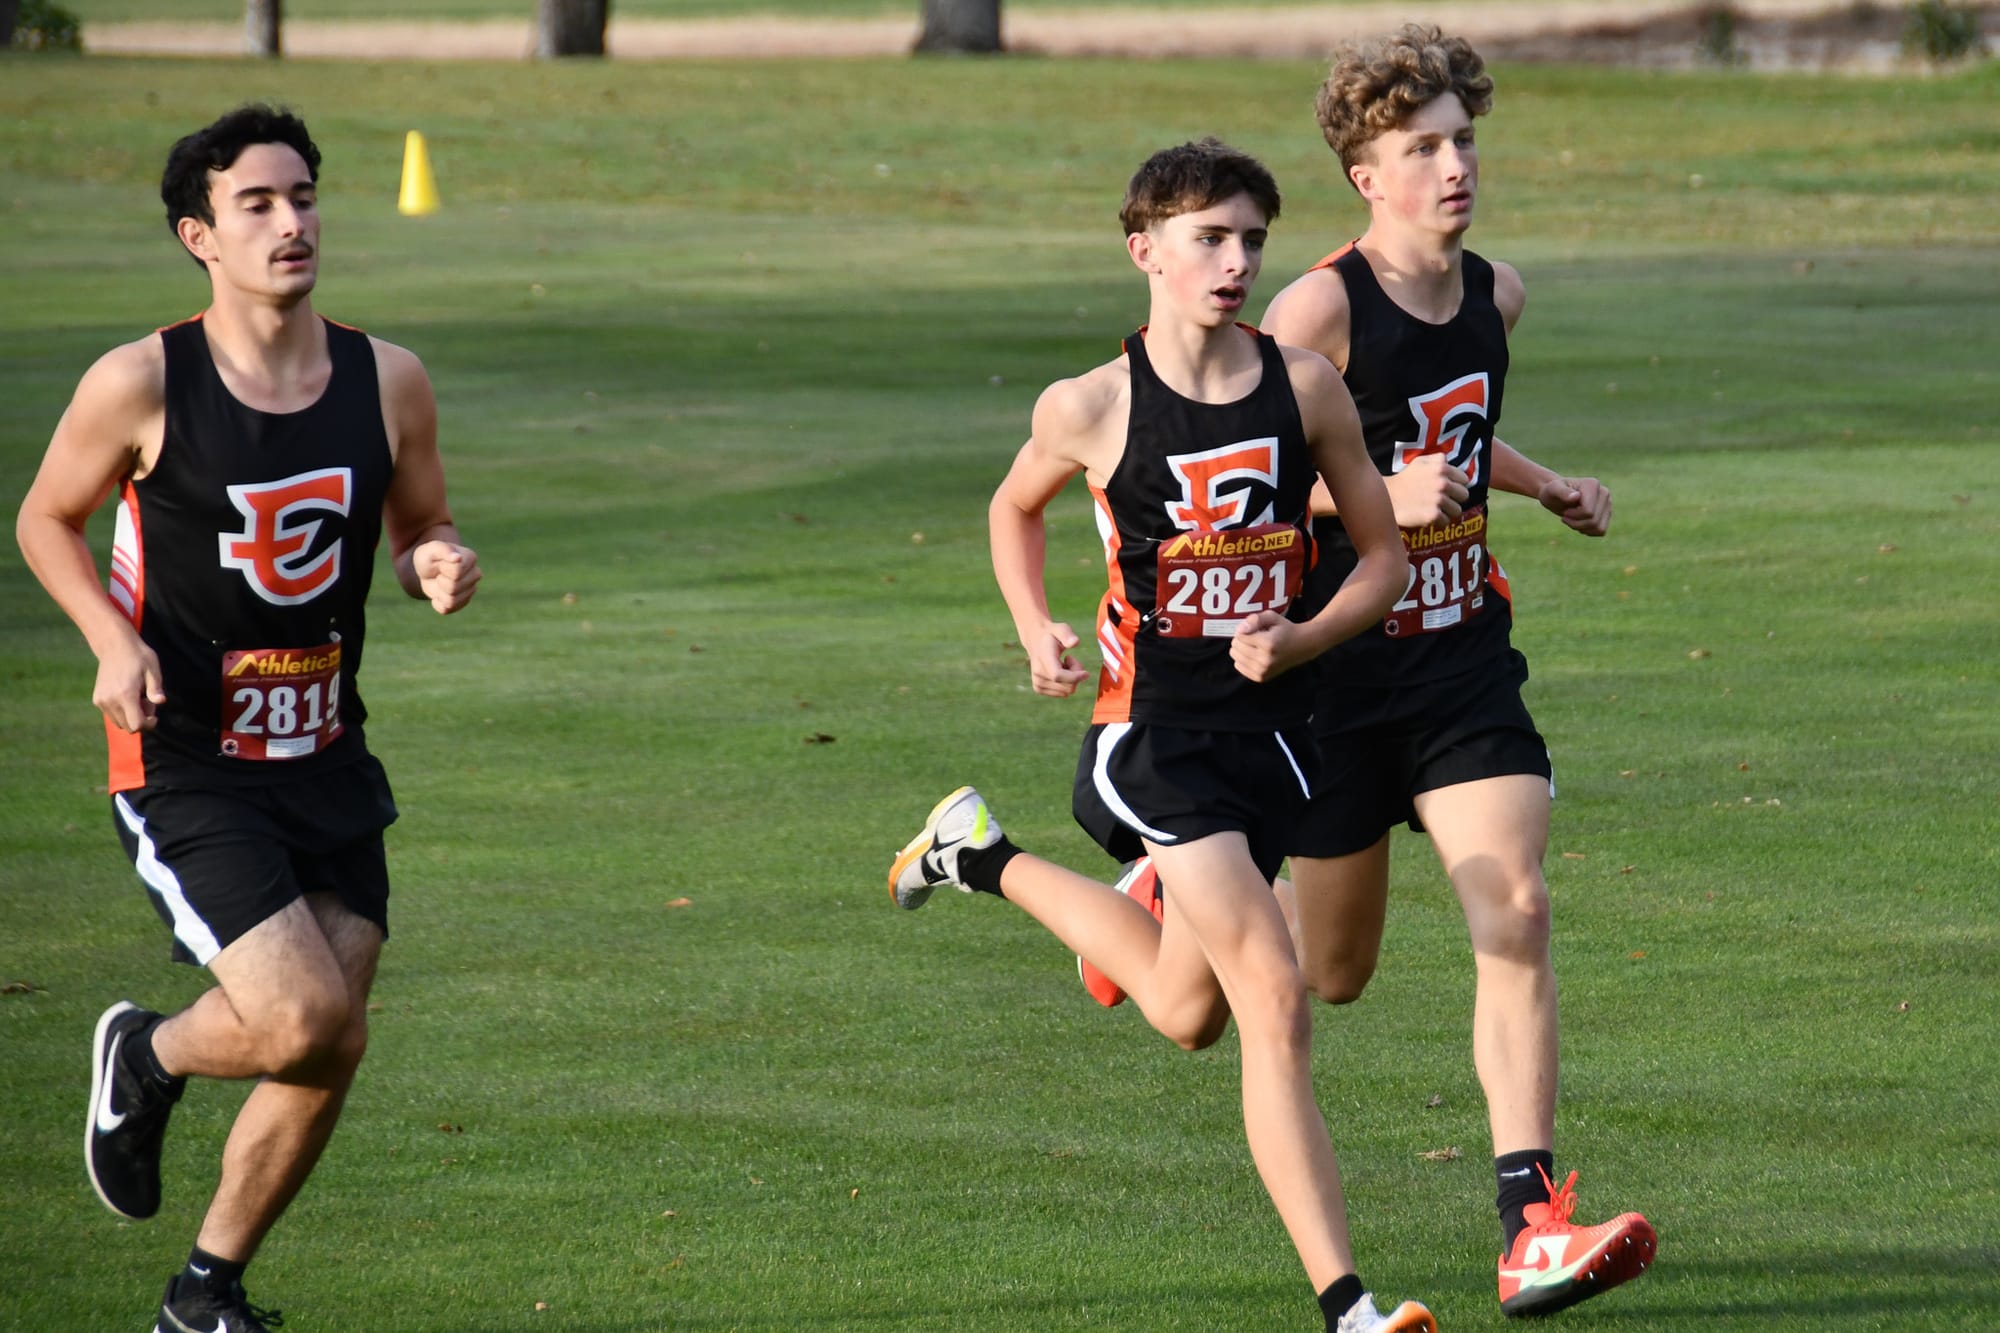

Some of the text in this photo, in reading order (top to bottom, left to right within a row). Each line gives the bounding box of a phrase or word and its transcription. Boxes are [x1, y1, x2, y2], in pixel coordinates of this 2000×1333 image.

[218, 466, 352, 606] E
[1167, 560, 1289, 615] 2821
[232, 670, 340, 735] 2819
